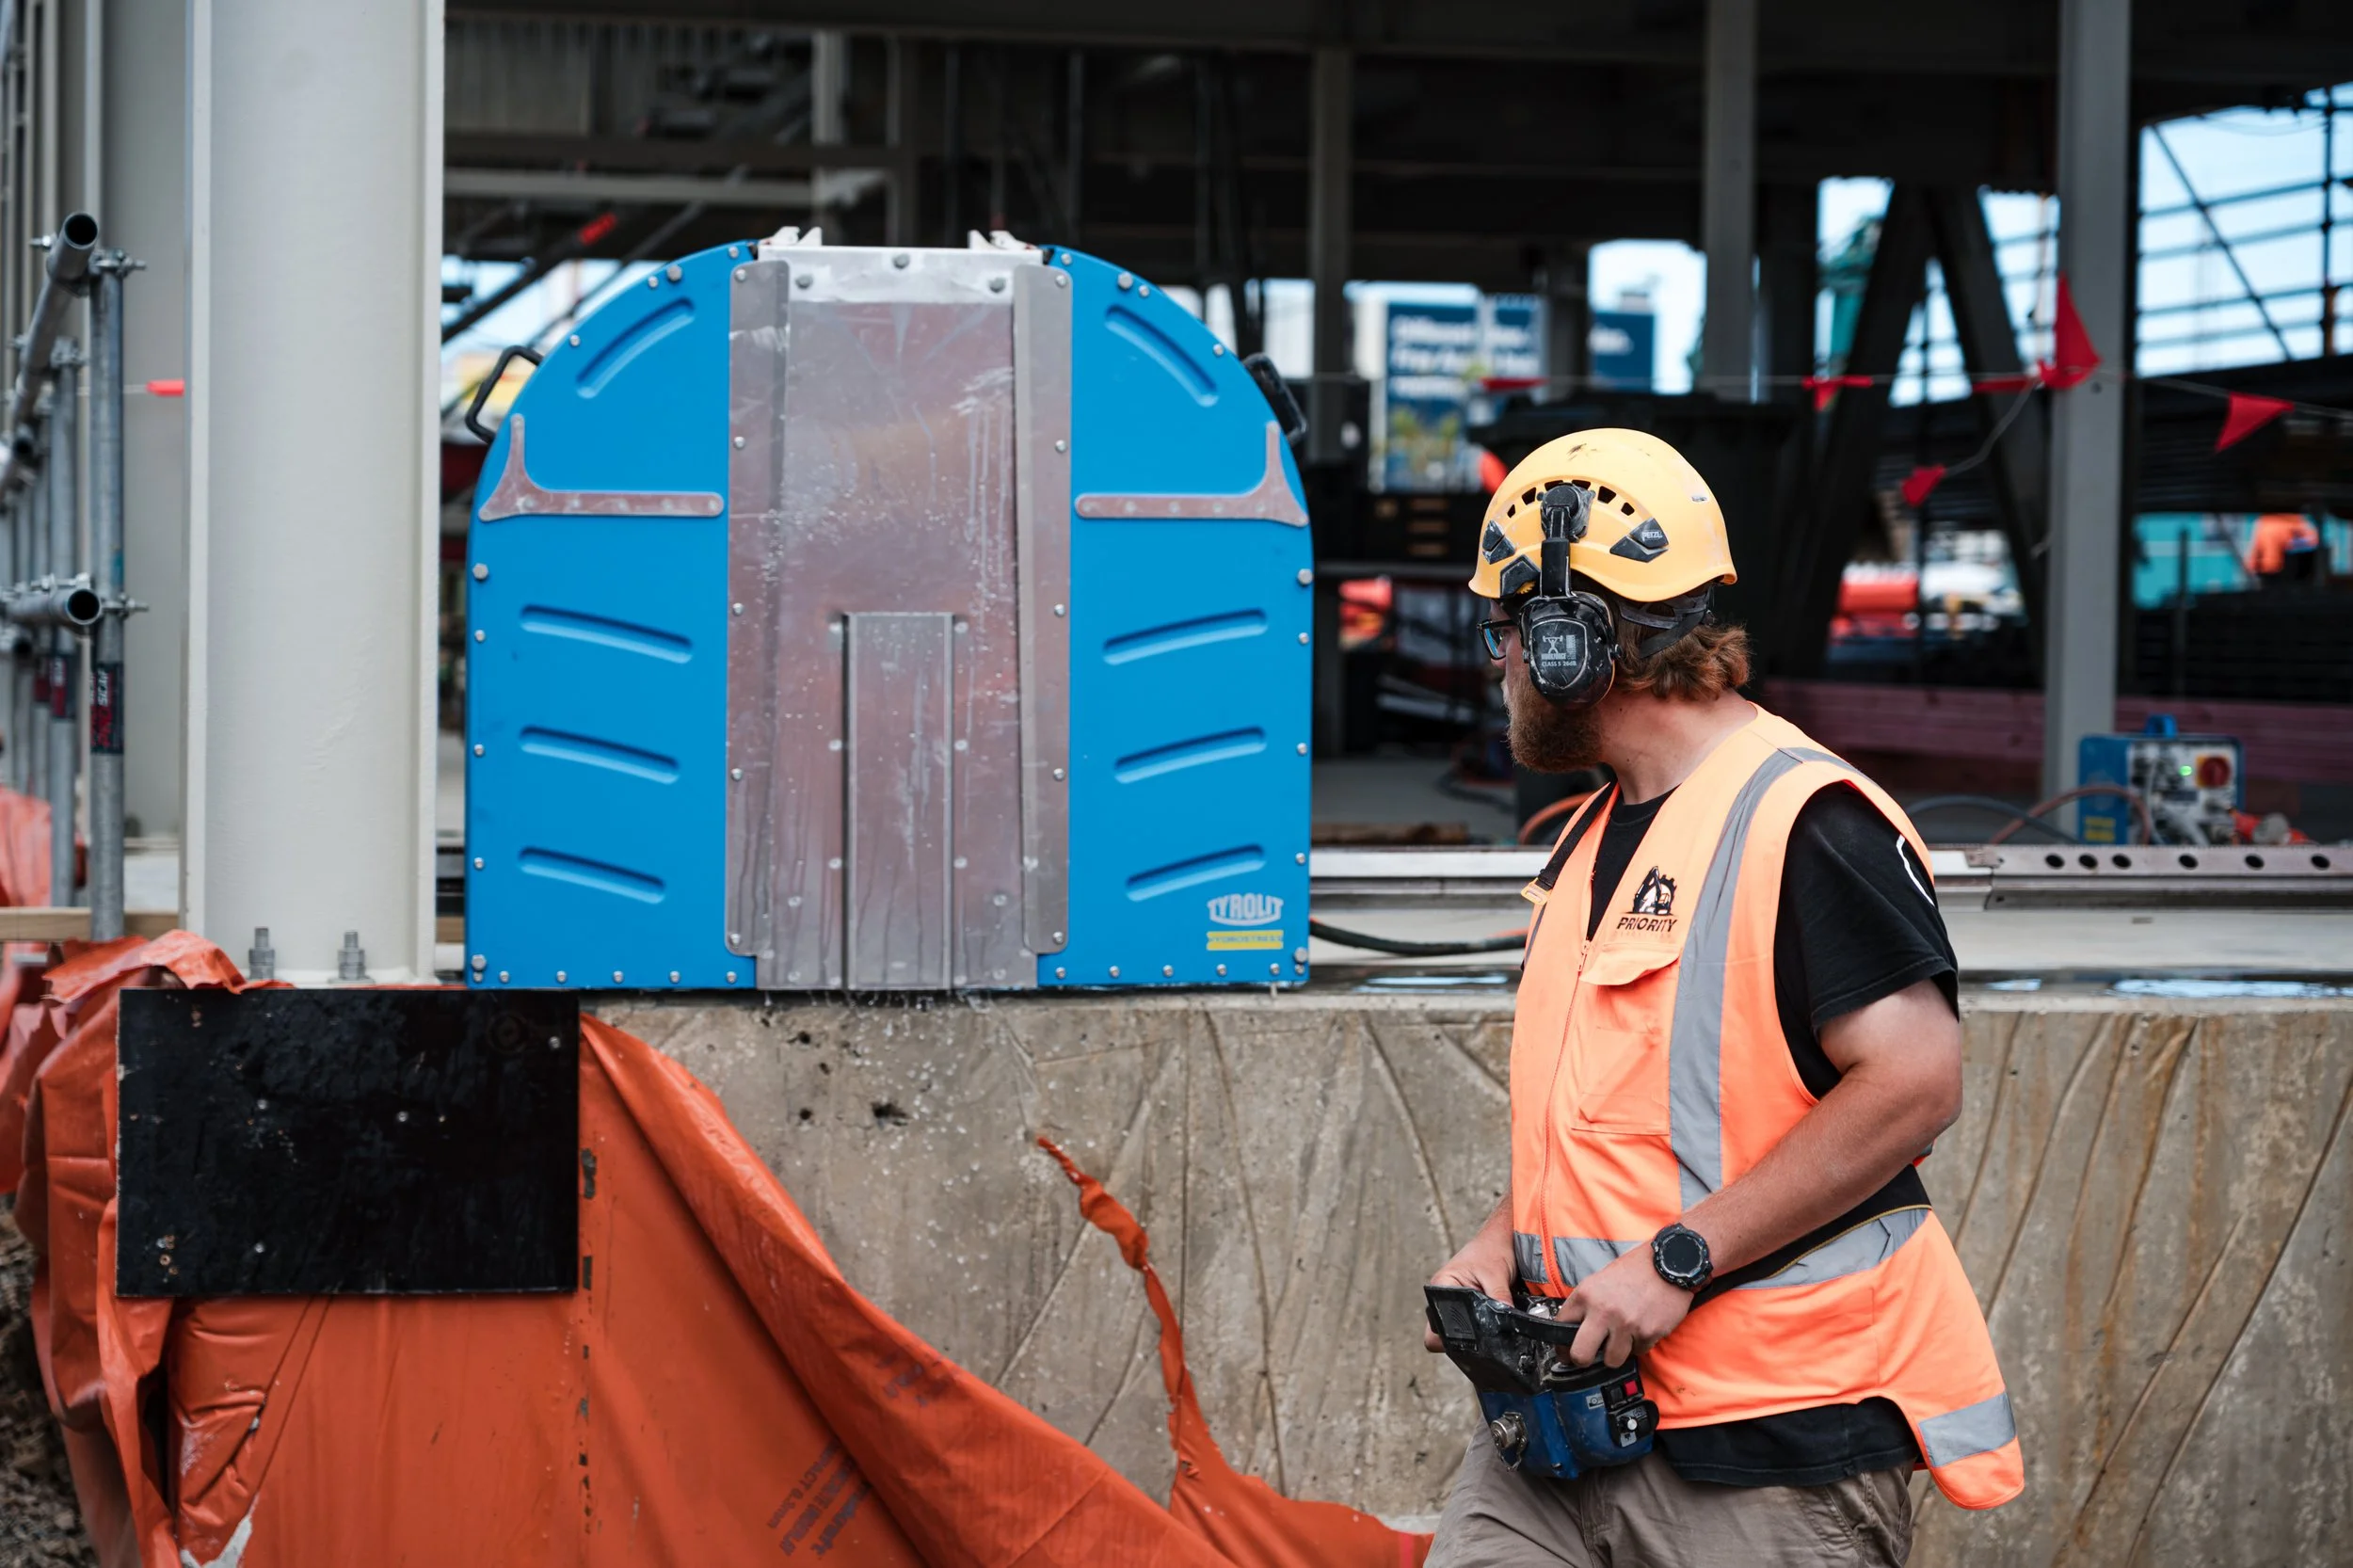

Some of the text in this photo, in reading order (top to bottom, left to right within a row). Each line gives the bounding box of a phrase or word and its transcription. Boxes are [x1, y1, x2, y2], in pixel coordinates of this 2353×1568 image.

[1641, 530, 1663, 542] PETZL
[1207, 892, 1284, 925] TYROLIT
[1616, 917, 1678, 932] PRIORITY
